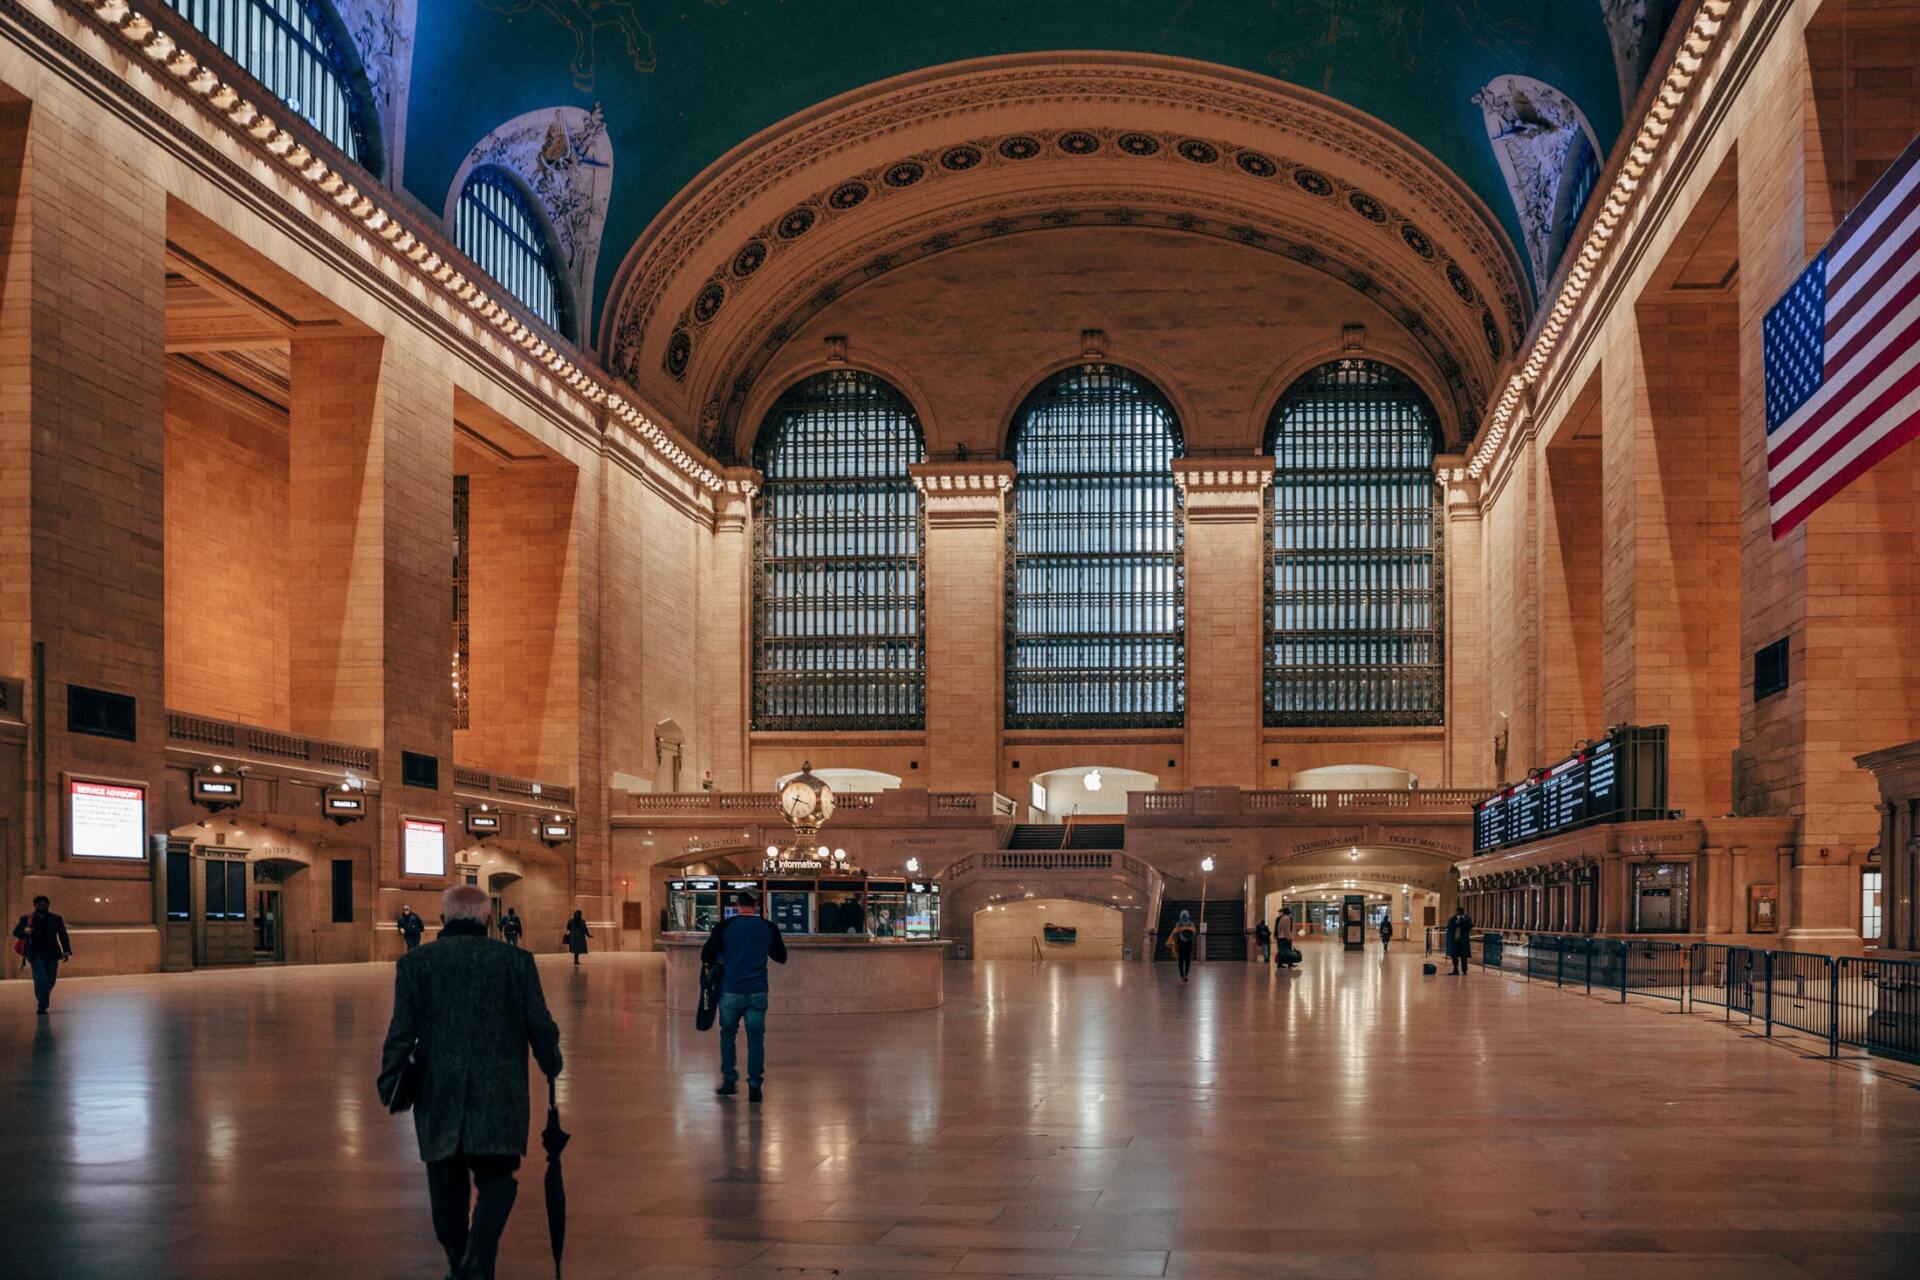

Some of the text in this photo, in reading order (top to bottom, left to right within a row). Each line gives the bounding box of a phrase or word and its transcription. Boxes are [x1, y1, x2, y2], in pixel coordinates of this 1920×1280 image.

[77, 785, 105, 796] SERVICE
[1291, 835, 1360, 853] LEXINGTON AVE
[1389, 836, 1418, 845] TICKET
